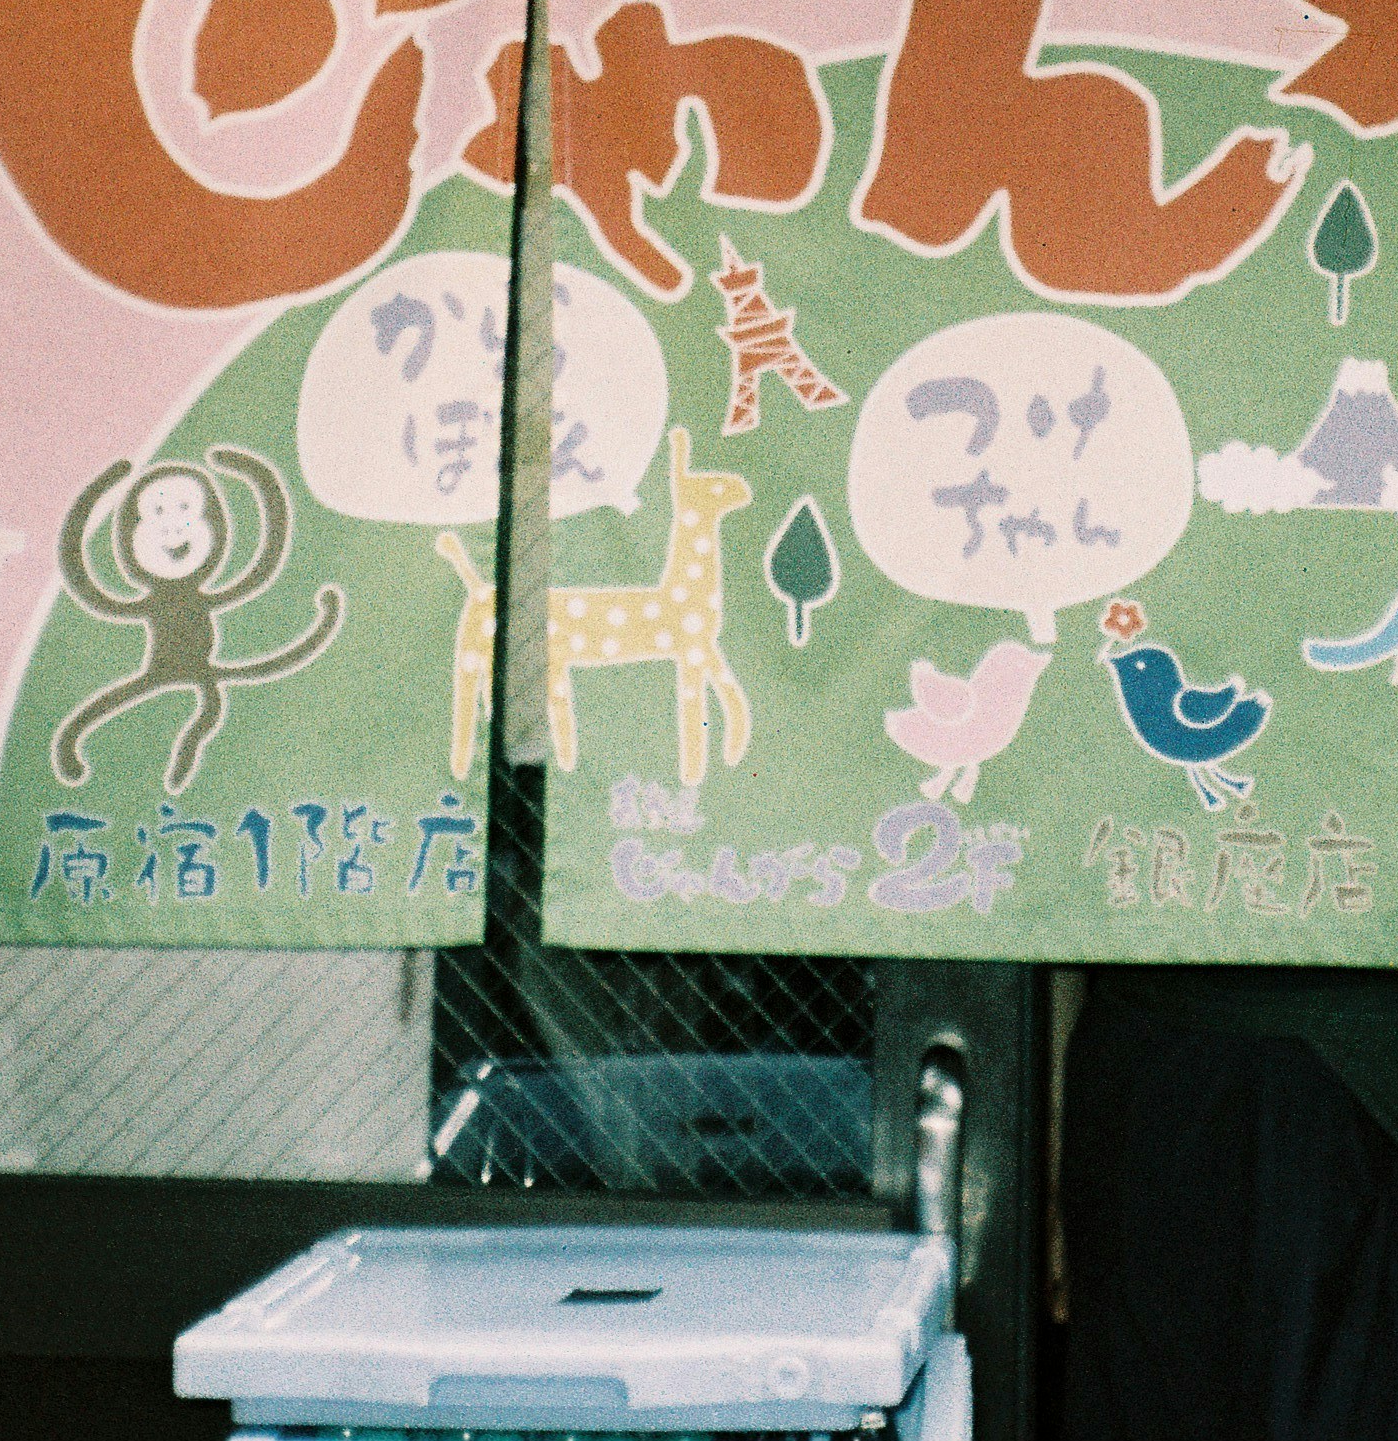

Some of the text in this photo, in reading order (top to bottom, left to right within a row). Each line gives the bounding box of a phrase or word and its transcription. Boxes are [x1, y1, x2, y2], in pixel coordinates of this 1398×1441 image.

[904, 364, 1111, 457] つけ
[931, 477, 1124, 559] ちゃん
[30, 793, 479, 901] 原宿1階店
[1082, 802, 1379, 919] 銀座店
